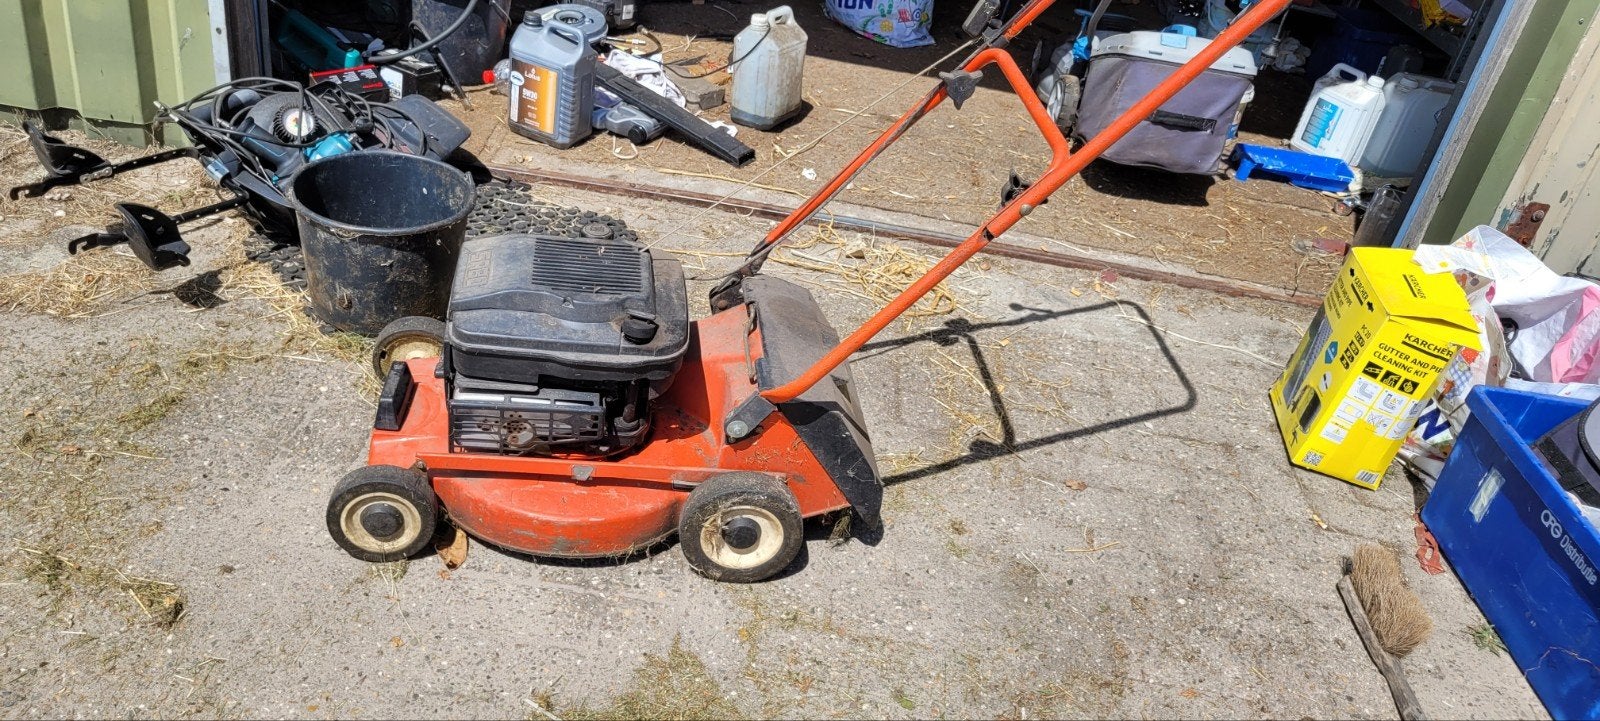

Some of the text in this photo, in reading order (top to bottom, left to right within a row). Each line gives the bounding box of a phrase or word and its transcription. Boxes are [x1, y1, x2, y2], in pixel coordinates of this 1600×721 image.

[1373, 350, 1414, 373] CLEANING
[1413, 368, 1429, 379] KIT
[1378, 342, 1411, 362] GUTTER
[1411, 358, 1430, 369] AND
[1560, 535, 1597, 585] Distributie
